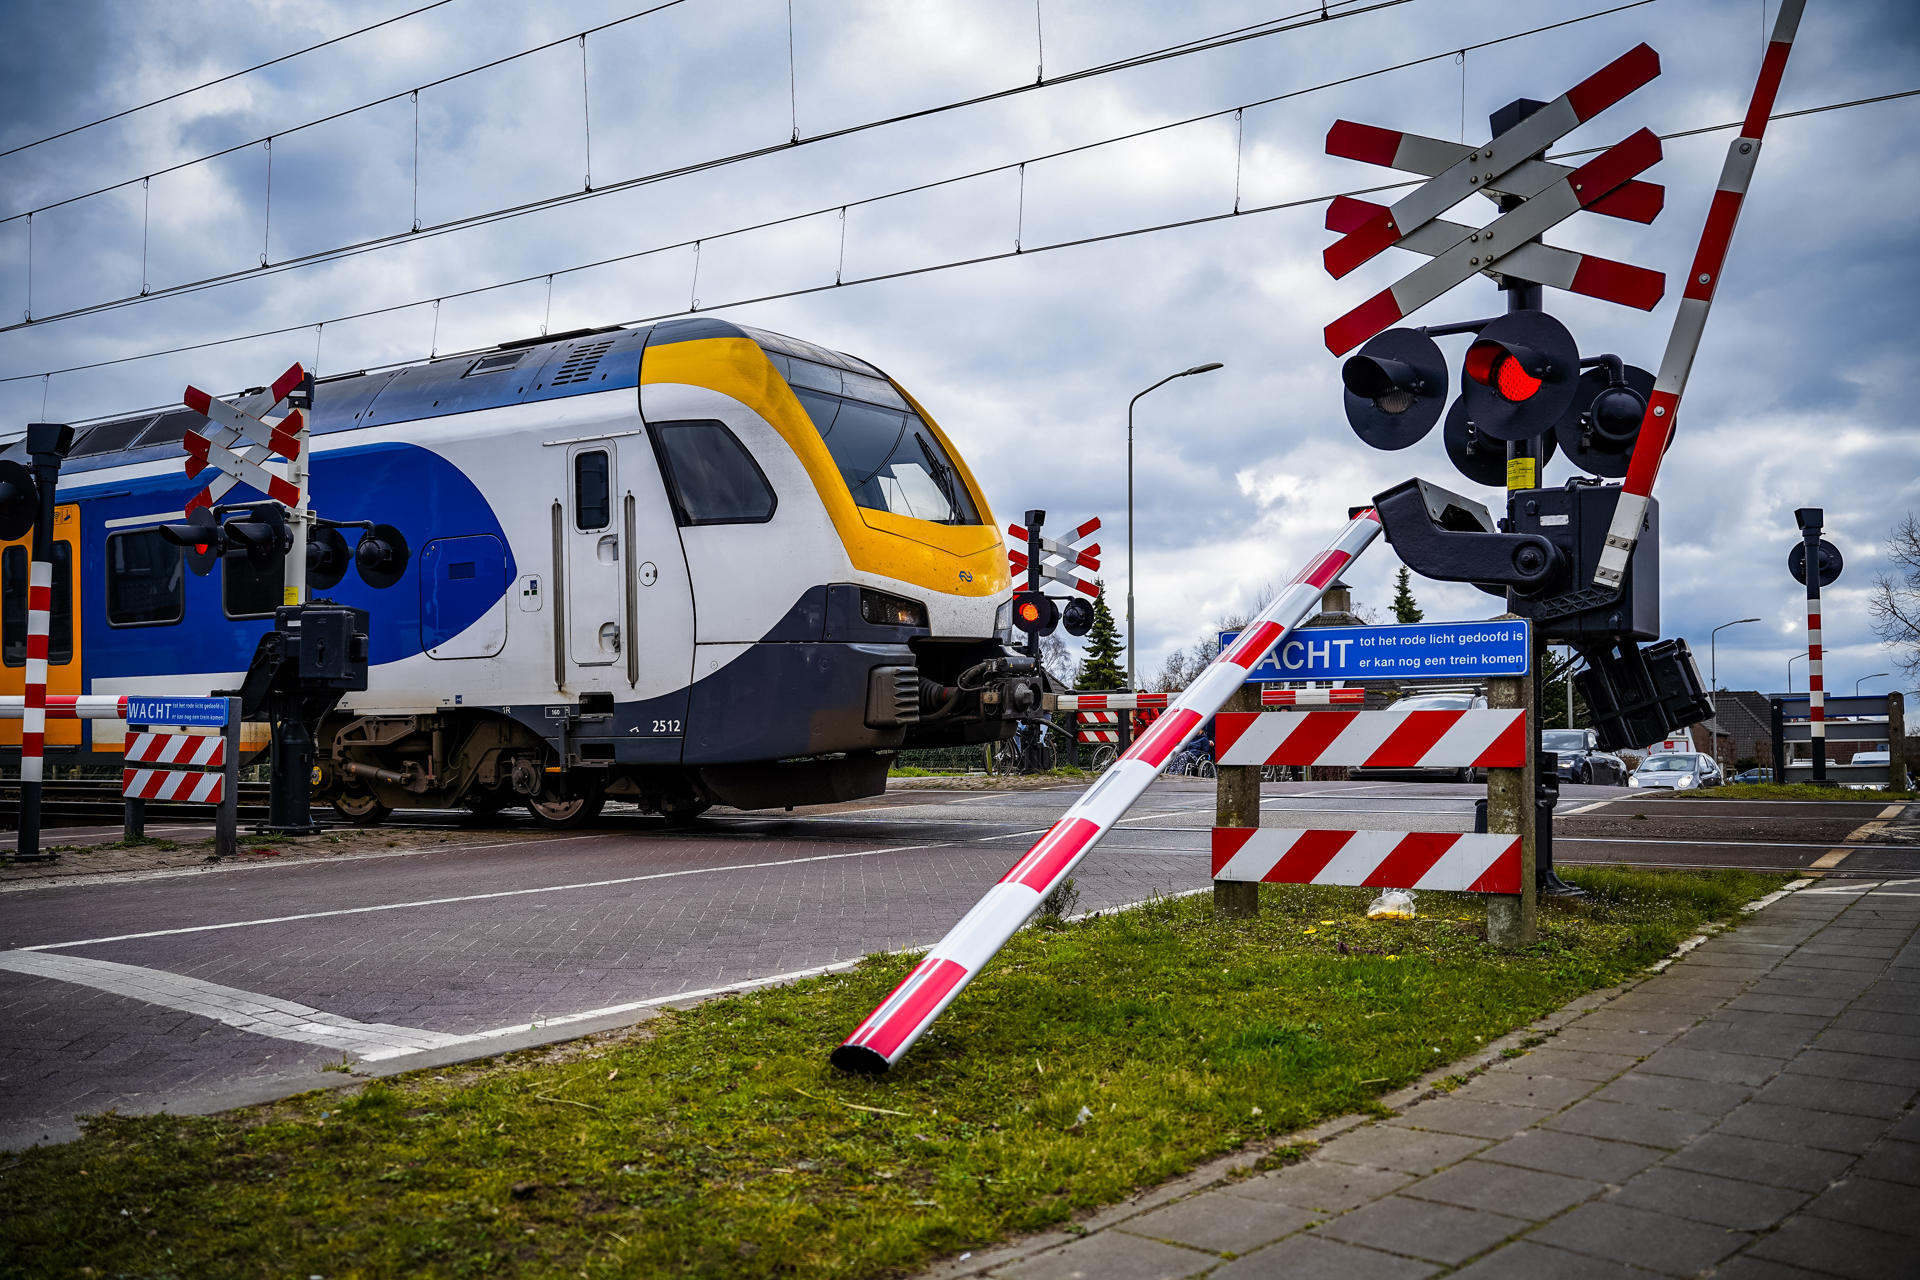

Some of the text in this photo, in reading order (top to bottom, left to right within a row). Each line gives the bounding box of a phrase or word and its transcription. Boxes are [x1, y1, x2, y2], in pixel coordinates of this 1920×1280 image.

[1359, 630, 1524, 647] tot het rode licht gedoofd is
[1224, 639, 1354, 670] ACHT
[1359, 653, 1523, 668] er kan nog een trein komen
[128, 703, 172, 719] WACHT
[652, 719, 681, 732] 2512
